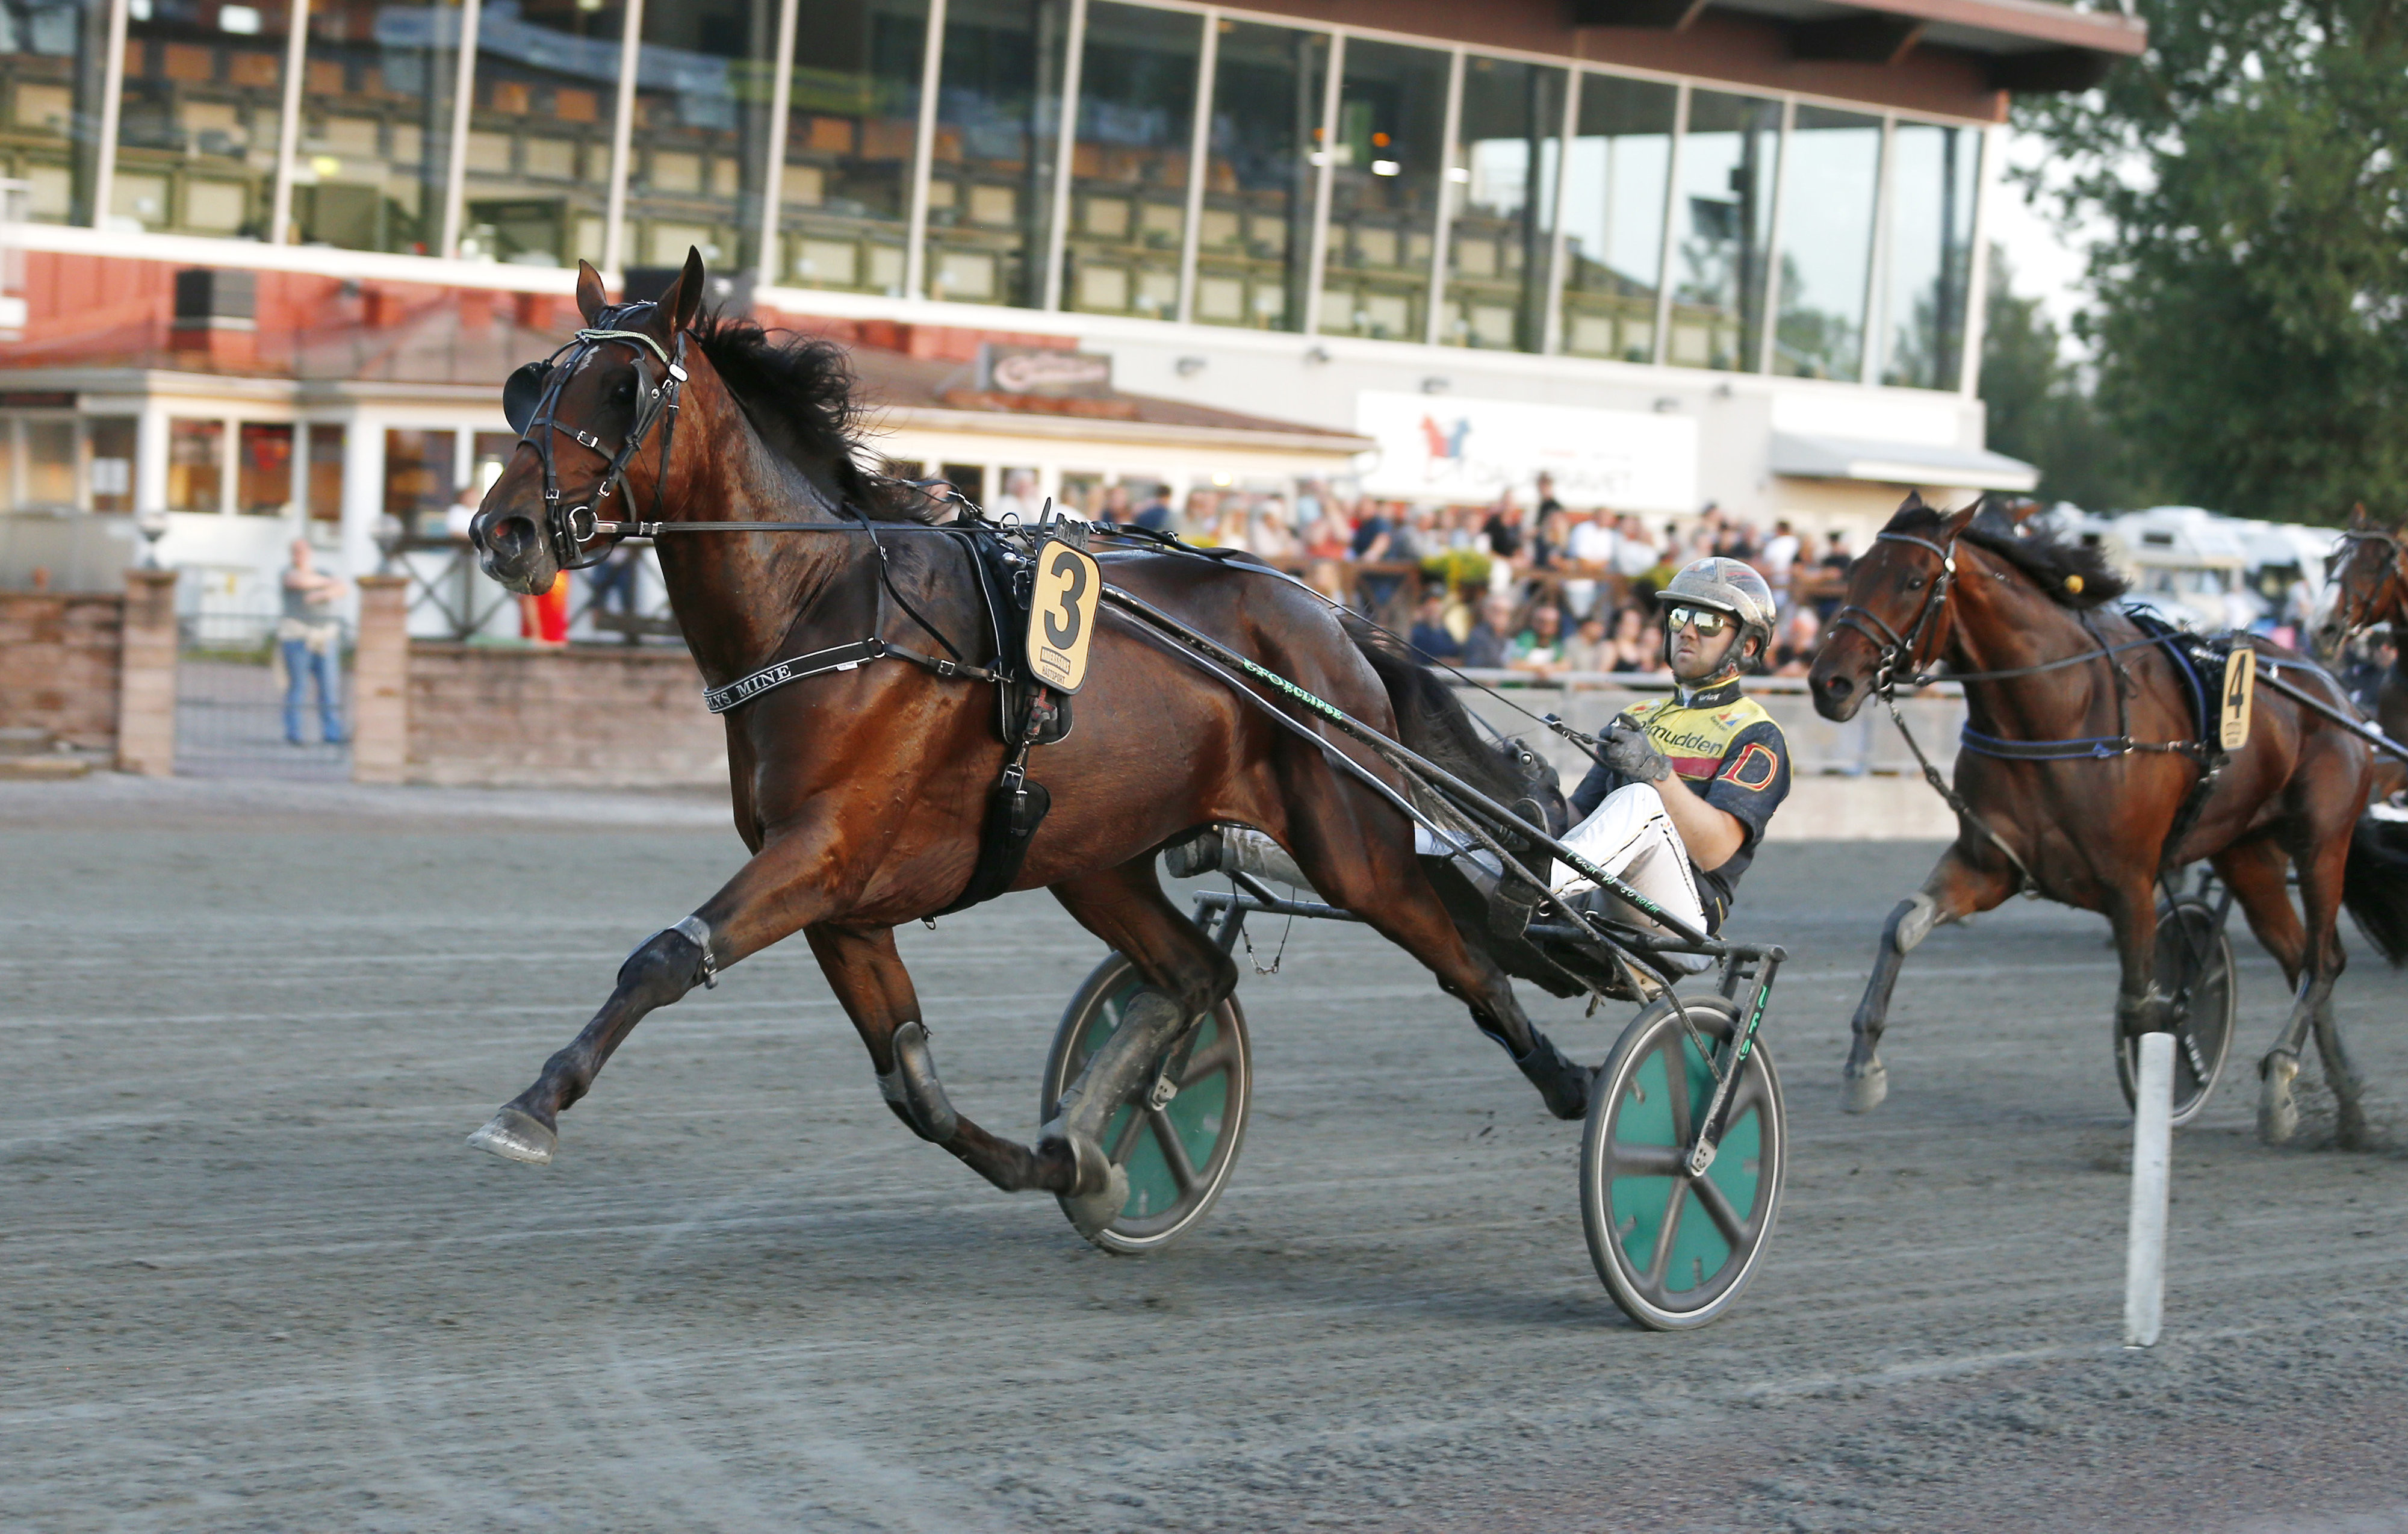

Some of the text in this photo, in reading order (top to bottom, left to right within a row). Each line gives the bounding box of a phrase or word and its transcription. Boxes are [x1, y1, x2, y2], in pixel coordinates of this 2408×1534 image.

[1044, 551, 1087, 650] 3
[1041, 647, 1070, 674] ANDERSSONS
[1042, 664, 1065, 685] HÄSTSPORT
[736, 664, 792, 698] MINE
[2227, 653, 2246, 719] 4
[1641, 720, 1723, 756] mudden
[1716, 742, 1778, 793] D
